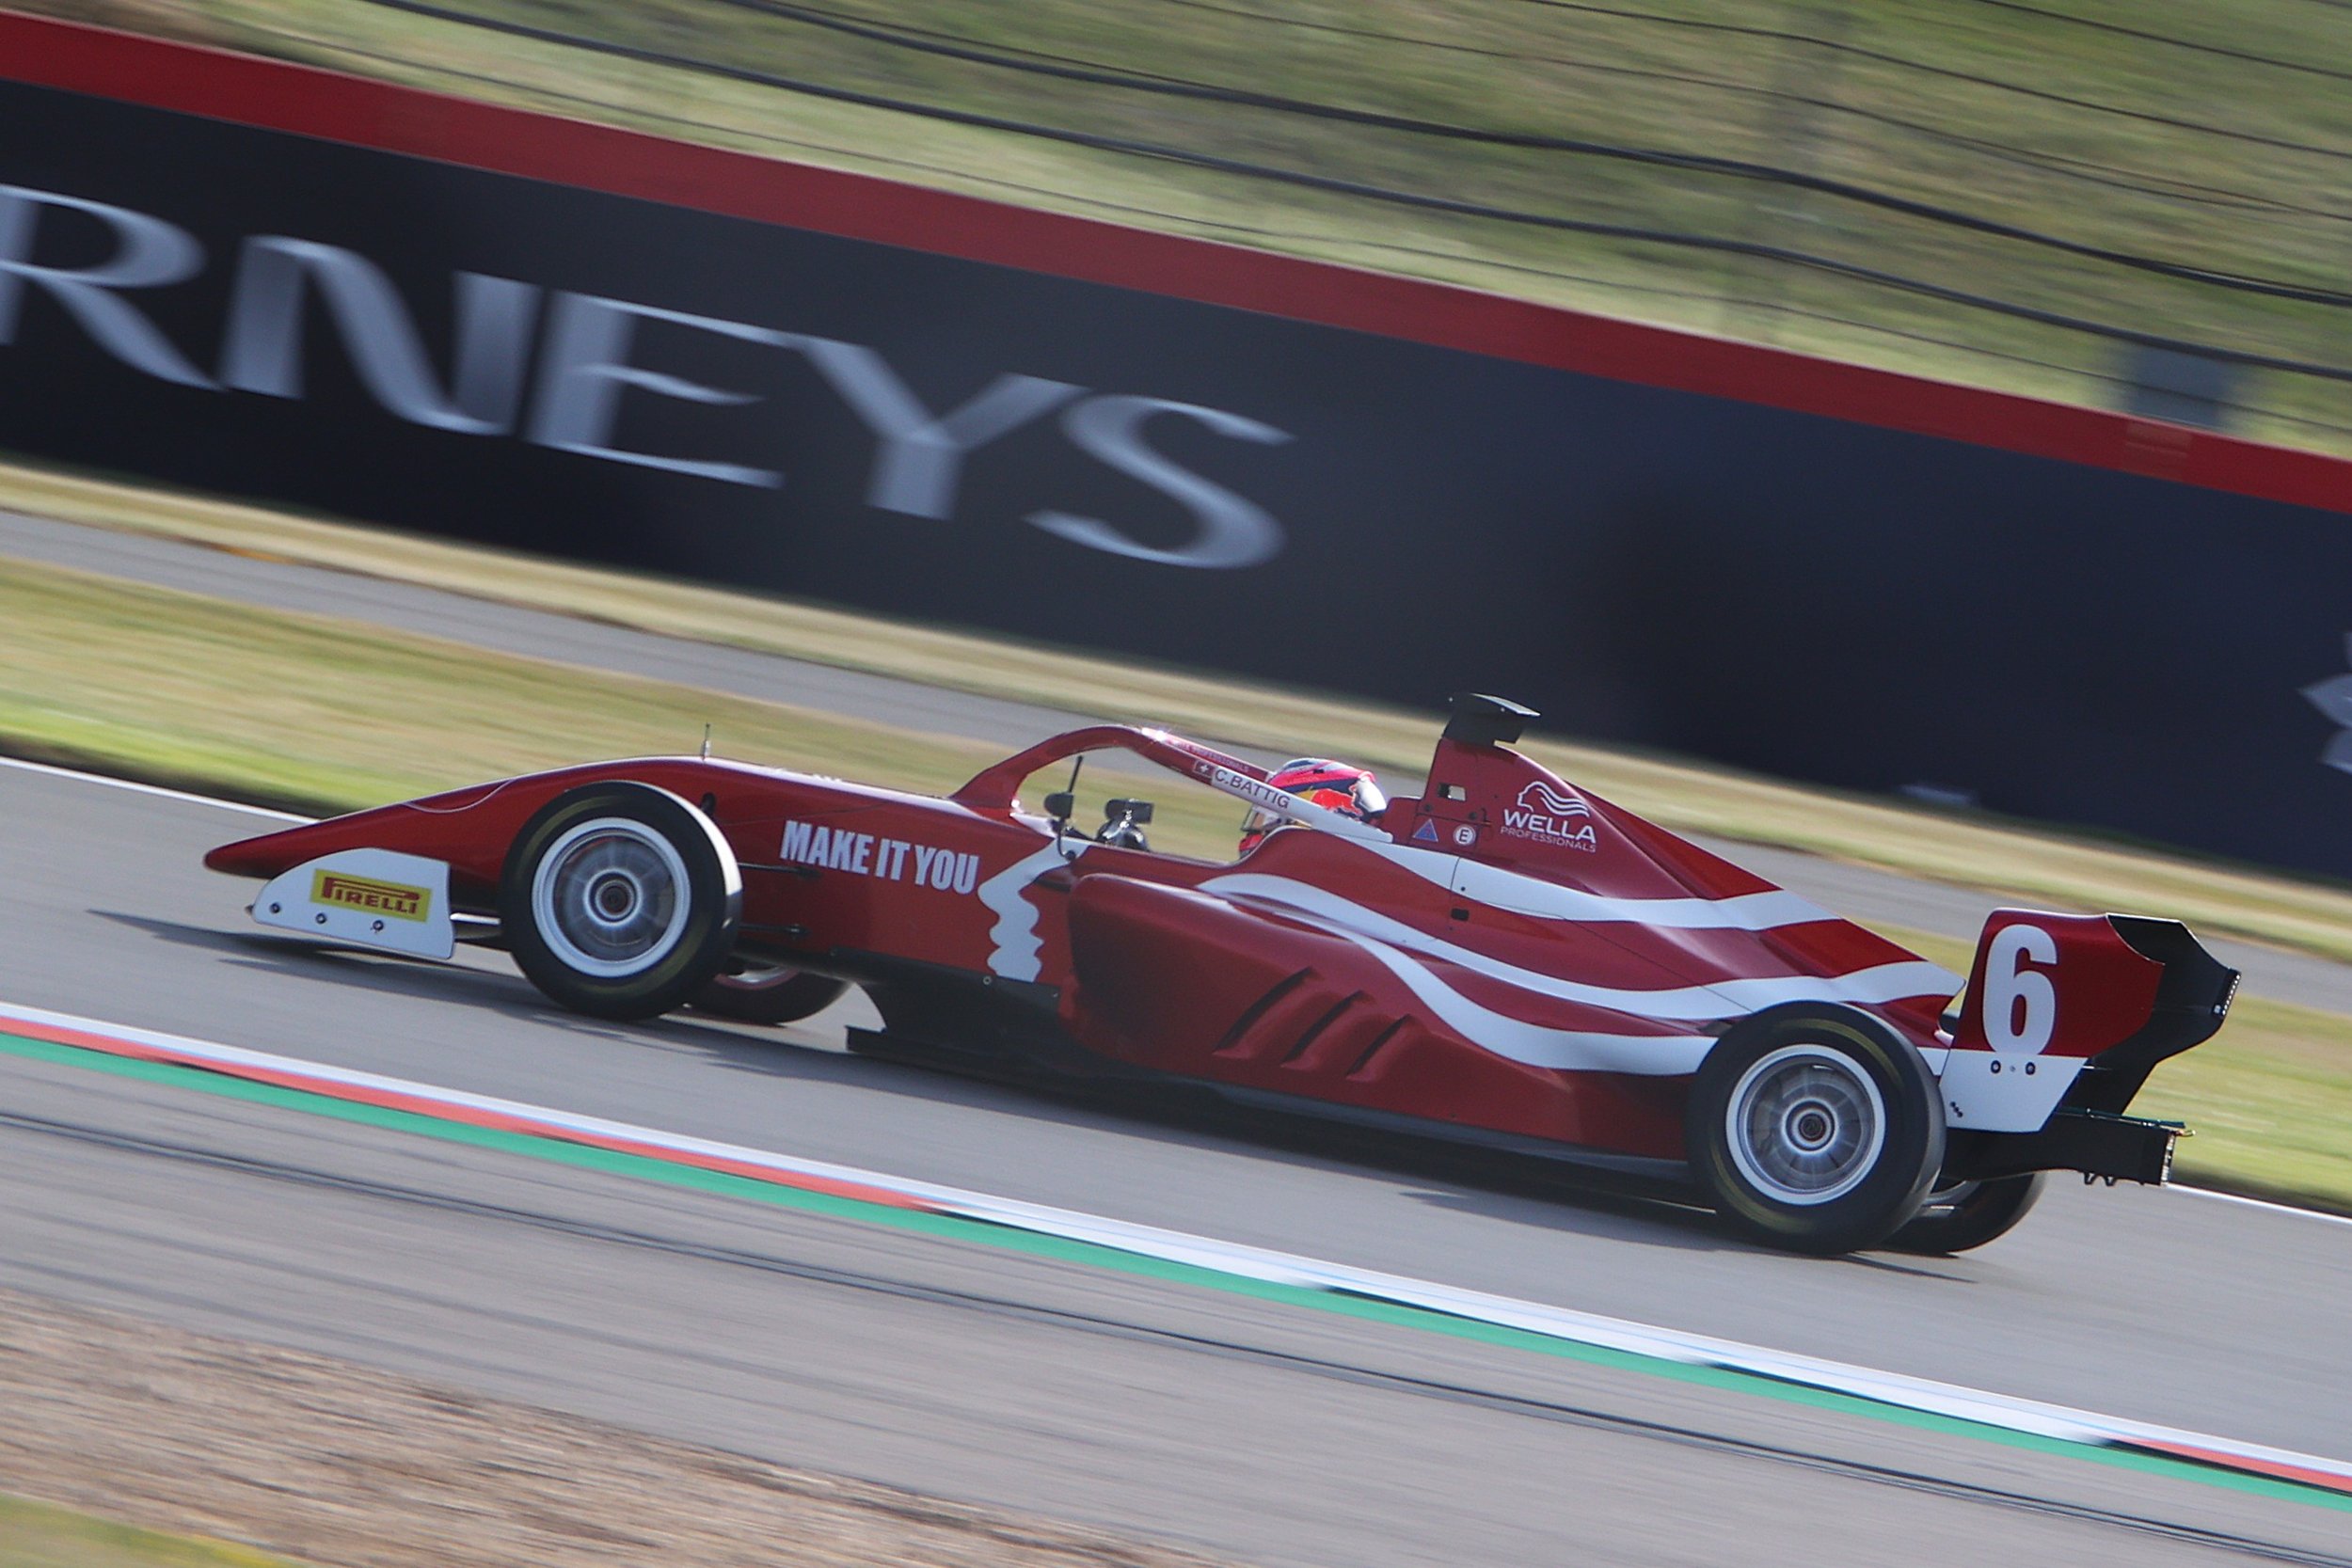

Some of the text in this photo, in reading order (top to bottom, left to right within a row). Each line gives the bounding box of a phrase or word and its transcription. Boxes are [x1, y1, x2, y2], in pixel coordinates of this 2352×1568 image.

[0, 183, 1296, 567] RNEYS
[1215, 768, 1290, 809] C.BATTIG
[1459, 829, 1469, 842] E
[1501, 826, 1597, 853] PROFESSIONALS
[1503, 809, 1597, 844] WELLA
[780, 820, 979, 895] MAKE IT YOU
[322, 877, 421, 913] PIRELLI
[1982, 924, 2058, 1055] 6
